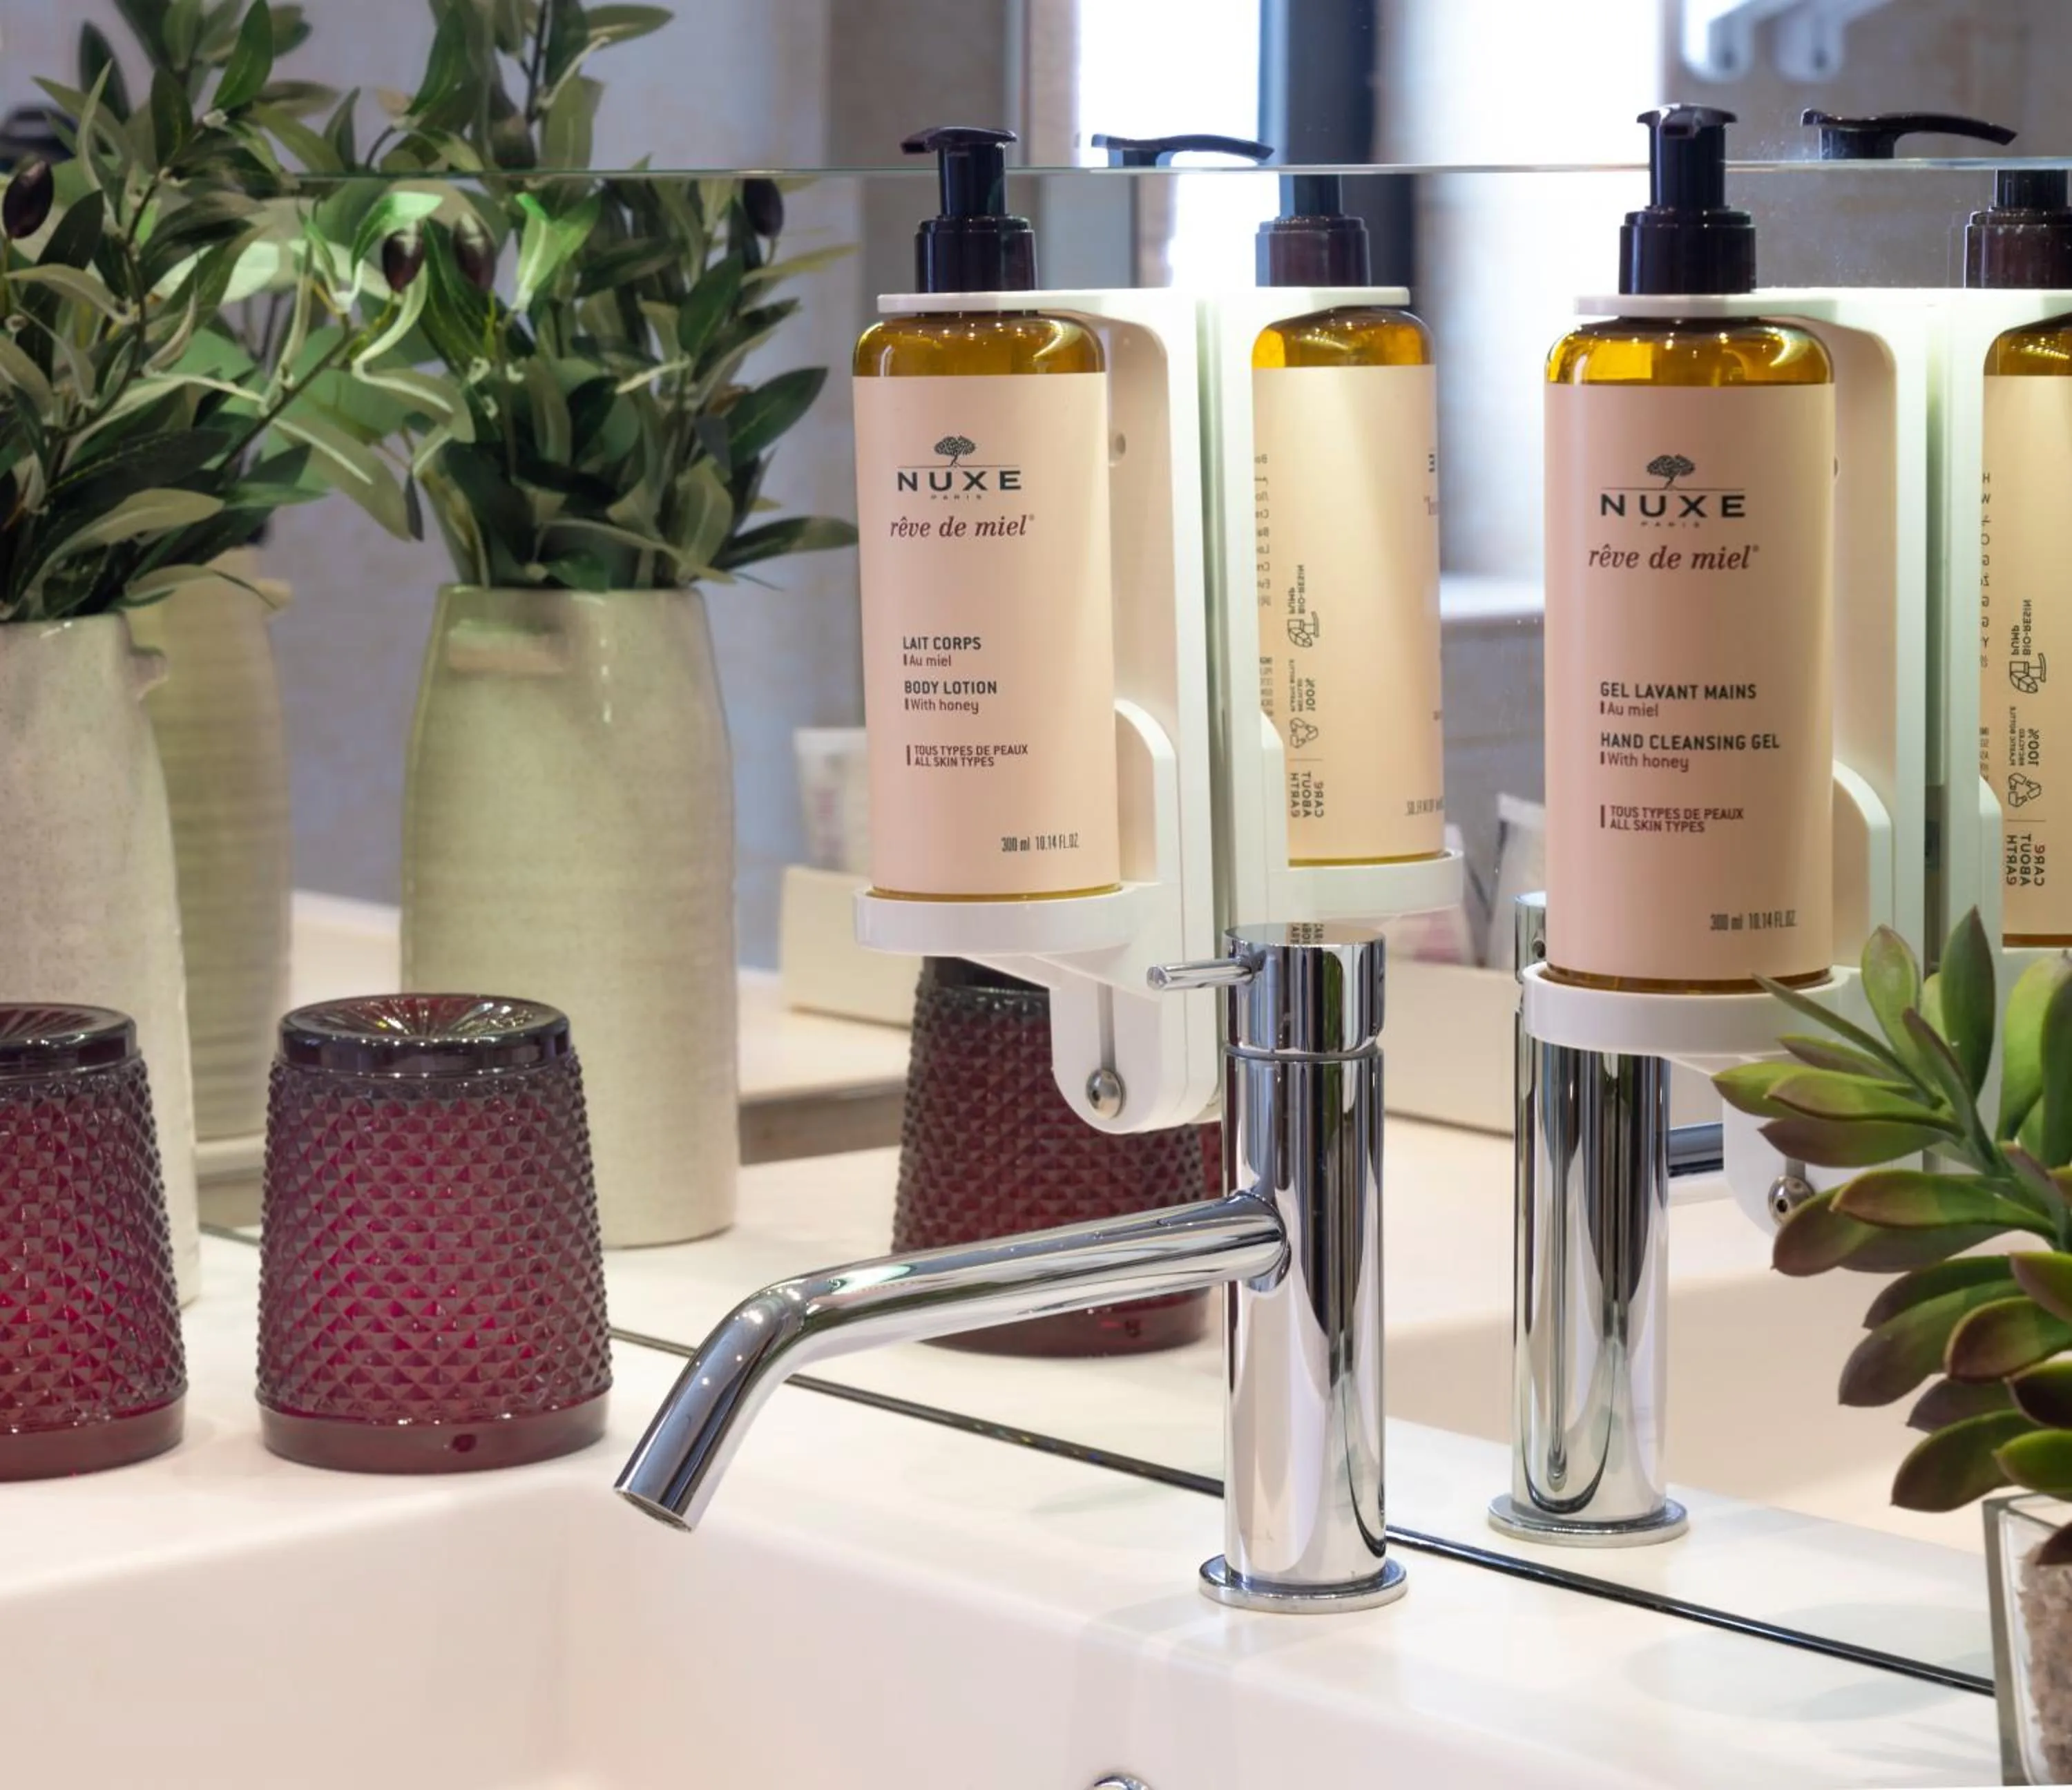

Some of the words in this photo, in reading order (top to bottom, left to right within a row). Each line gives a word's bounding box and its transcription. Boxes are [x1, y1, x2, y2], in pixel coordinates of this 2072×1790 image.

[898, 470, 1021, 492] NUXE
[1601, 494, 1745, 518] NUXE
[891, 517, 931, 537] rêve
[939, 516, 967, 537] de
[1589, 543, 1640, 568] rêve
[1649, 546, 1681, 570] de
[903, 636, 929, 650] LAIT
[933, 637, 981, 651] CORPS
[909, 653, 923, 666] Au
[926, 653, 952, 667] miel
[905, 680, 939, 695] BODY
[943, 681, 997, 695] LOTION
[1600, 681, 1629, 698] GEL
[1635, 684, 1698, 700] LAVANT
[1705, 684, 1756, 700] MAINS
[910, 698, 936, 711] With
[939, 699, 979, 715] honey
[1607, 702, 1624, 716] Au
[1628, 702, 1658, 717] miel
[914, 744, 938, 756] TOUS
[940, 746, 973, 756] TYPES
[976, 745, 990, 756] DE
[993, 744, 1028, 756] PEAUX
[1601, 732, 1644, 749] HAND
[1649, 734, 1746, 751] CLEANSING
[1751, 733, 1780, 750] GEL
[914, 756, 931, 767] ALL
[933, 756, 958, 767] SKIN
[960, 756, 995, 767] TYPES
[1607, 751, 1638, 767] With
[1642, 753, 1689, 773] honey
[1610, 805, 1640, 820] TOUS
[1642, 807, 1680, 820] TYPES
[1683, 808, 1701, 820] DE
[1704, 808, 1743, 820] PEAUX
[1610, 819, 1631, 830] ALL
[1633, 820, 1662, 831] SKIN
[1665, 820, 1705, 833] TYPES
[1001, 837, 1017, 852] 300
[1019, 836, 1030, 851] ml
[1035, 835, 1057, 851] 10.14
